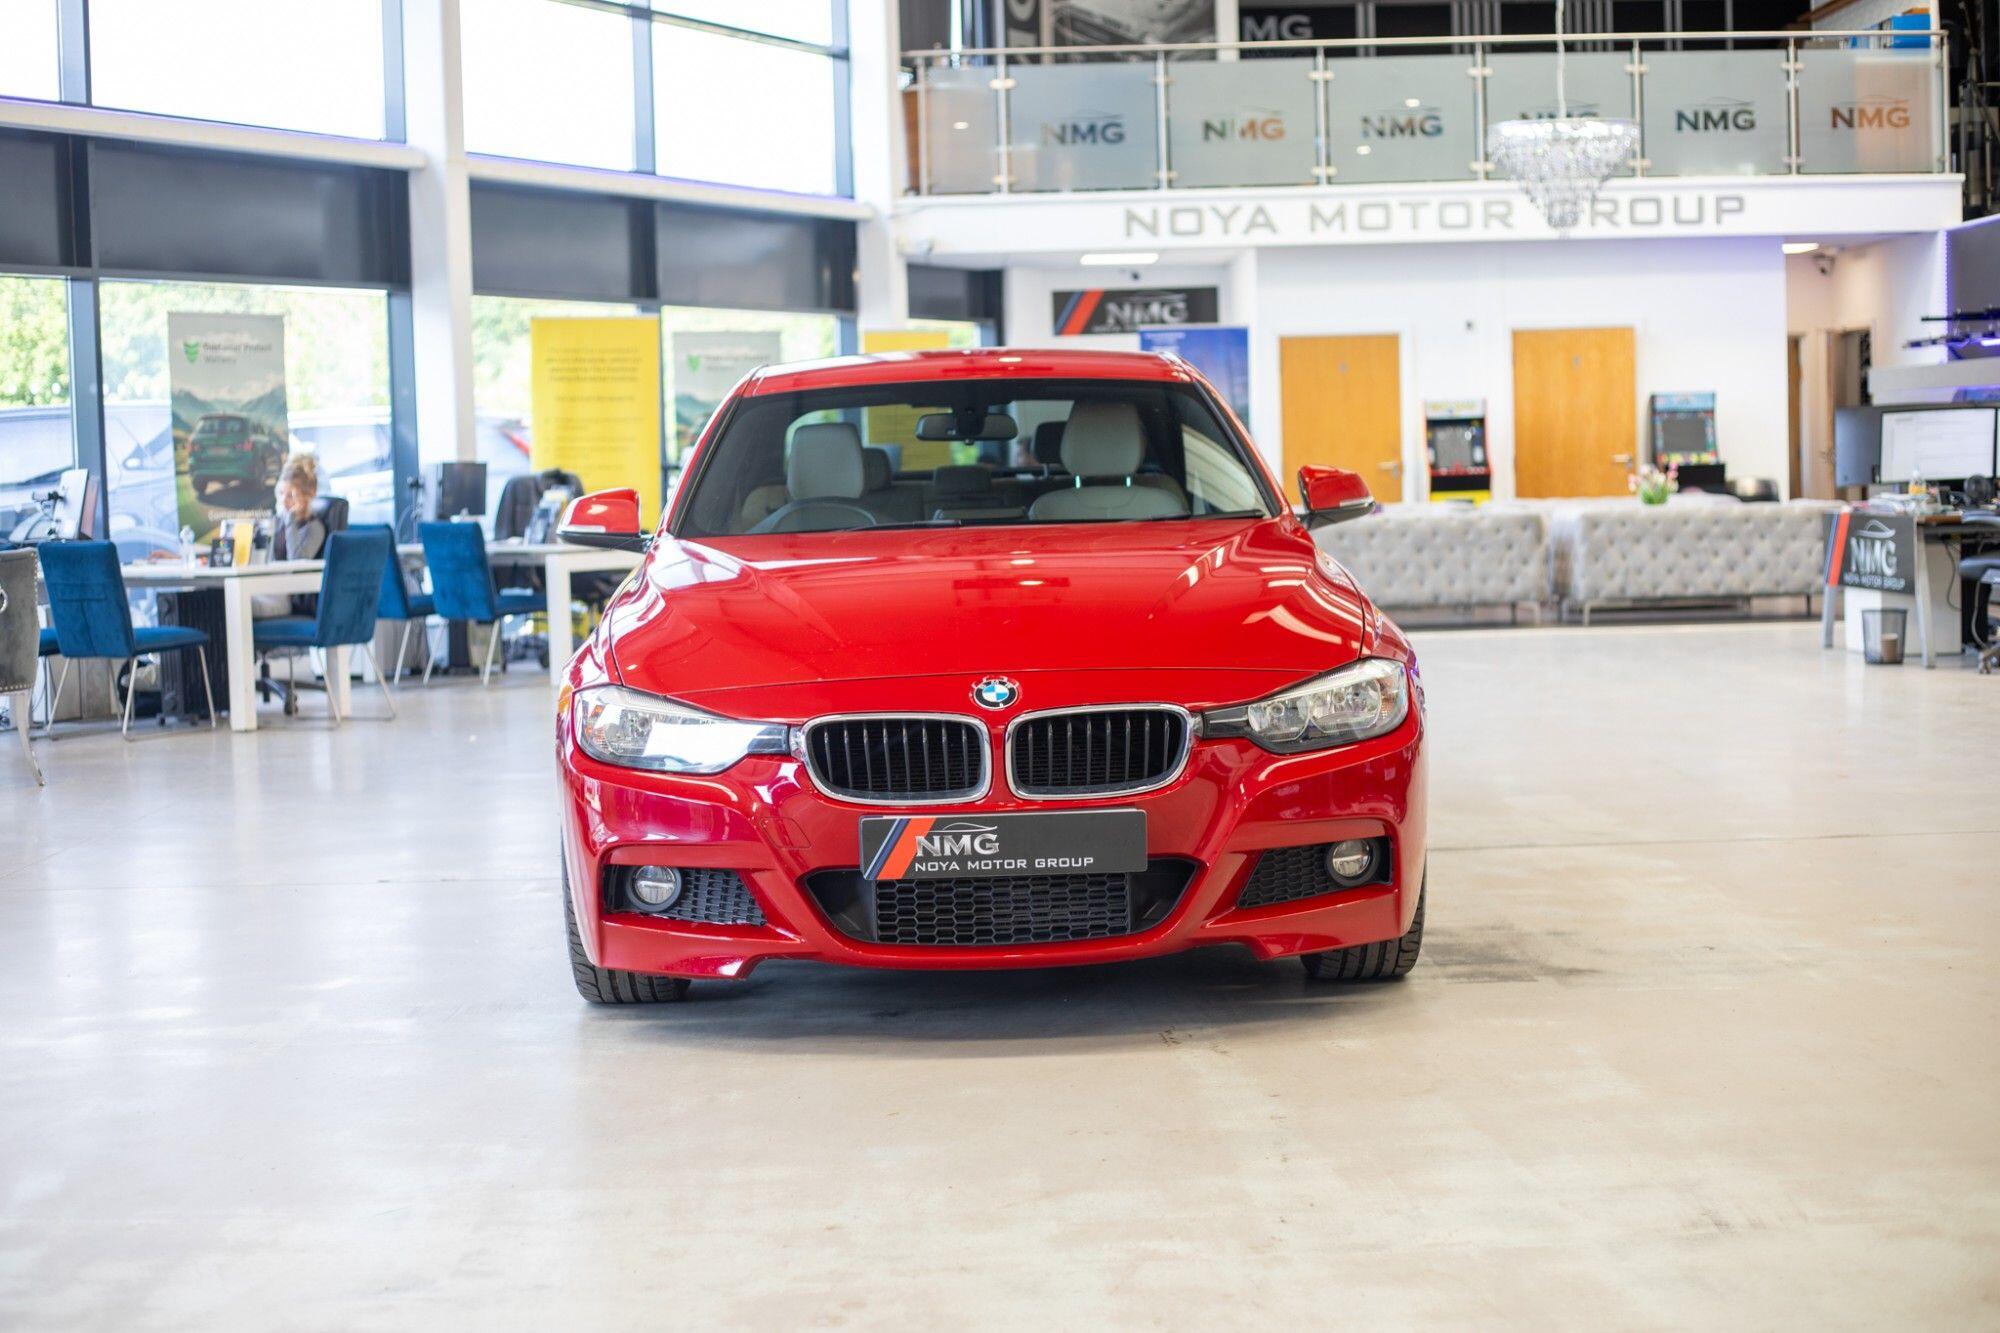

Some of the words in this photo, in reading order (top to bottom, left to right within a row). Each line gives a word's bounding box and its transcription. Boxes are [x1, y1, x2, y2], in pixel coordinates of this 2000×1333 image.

[1361, 114, 1443, 138] NMG
[1675, 108, 1756, 131] NMG
[1830, 106, 1911, 129] NMG
[1041, 121, 1126, 145] NMG
[1124, 205, 1278, 238] NOYA
[1310, 200, 1514, 233] MOTOR
[1105, 301, 1189, 324] NMG
[1850, 537, 1898, 577] NMG
[915, 834, 1000, 857] NMG
[915, 861, 961, 872] NOYA
[968, 859, 1027, 870] MOTOR
[1035, 857, 1094, 869] GROUP
